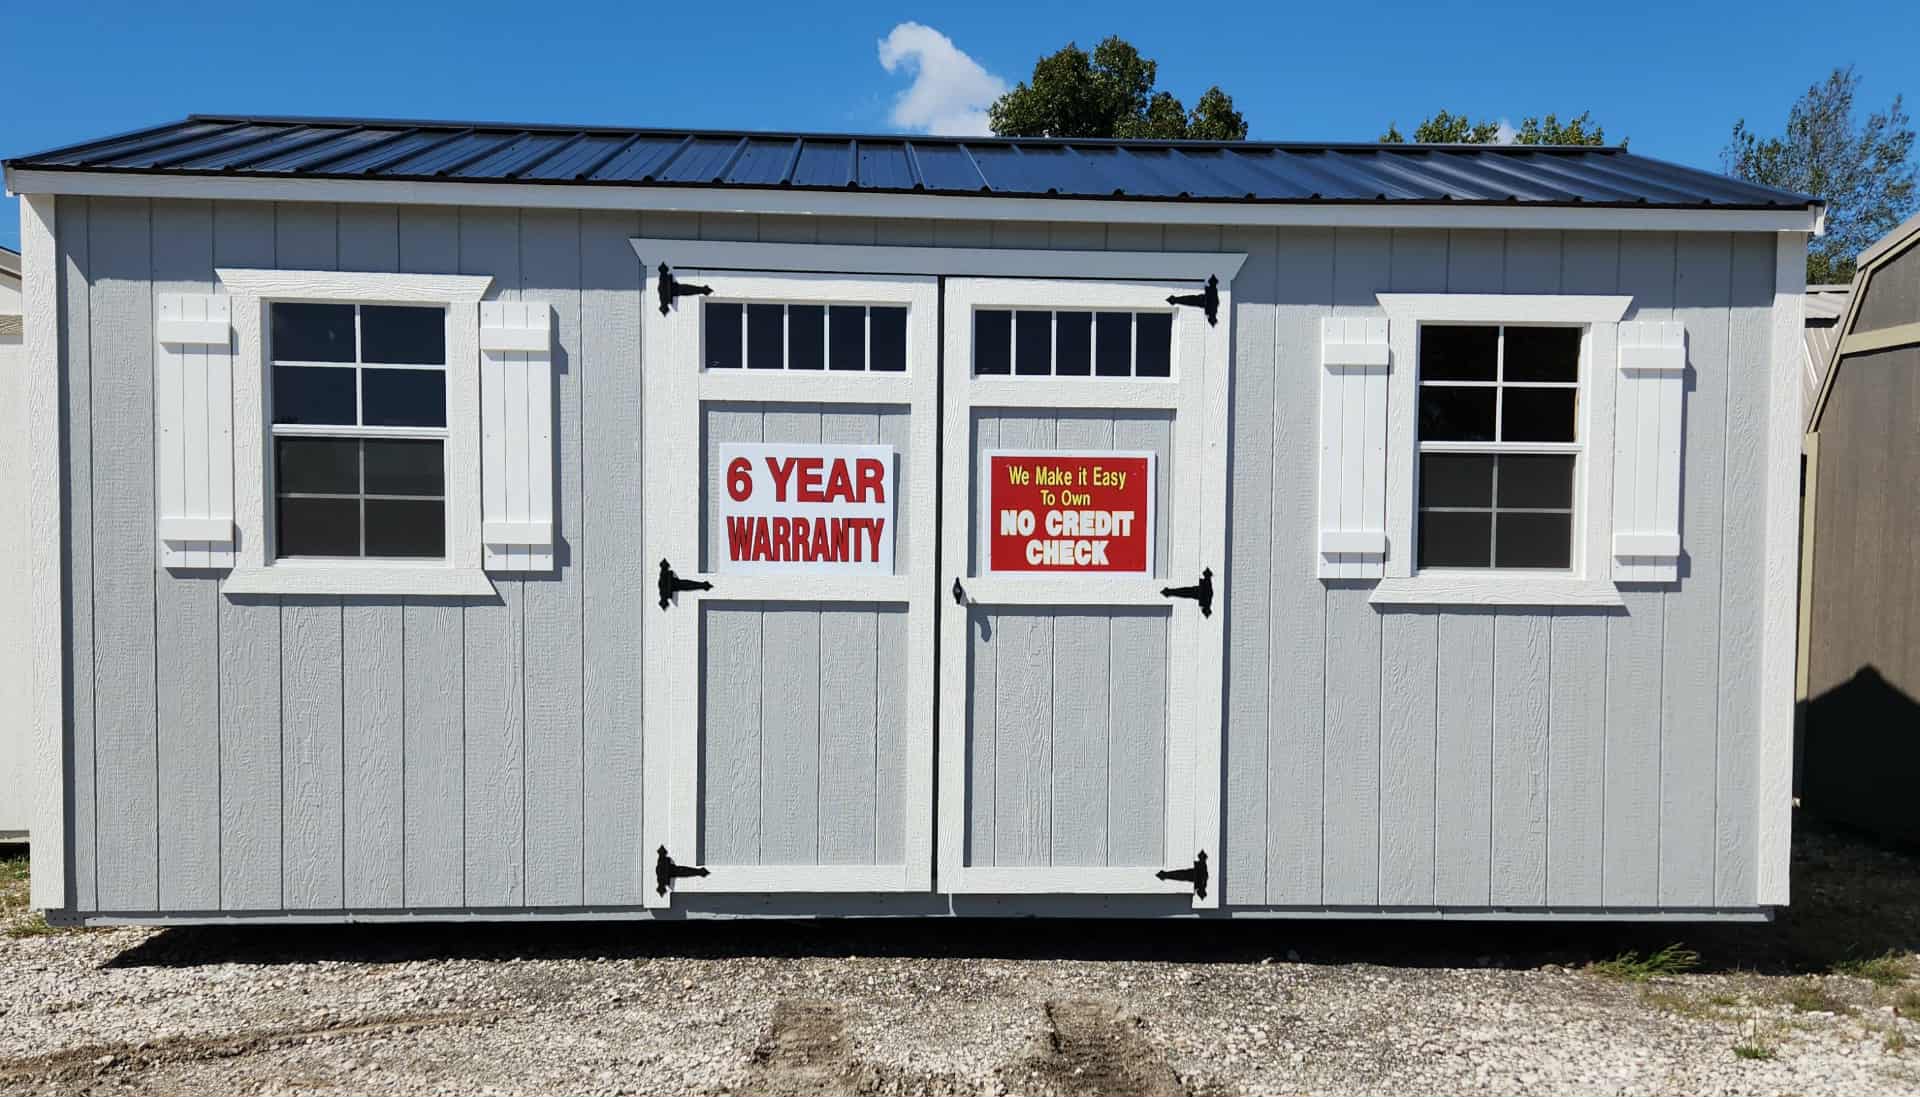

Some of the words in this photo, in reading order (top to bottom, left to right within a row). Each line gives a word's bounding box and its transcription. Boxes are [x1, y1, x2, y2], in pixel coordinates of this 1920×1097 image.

[726, 456, 753, 502] 6
[765, 457, 886, 503] YEAR
[1008, 465, 1030, 486] We
[1035, 466, 1073, 486] Make
[1078, 466, 1088, 486] it
[1093, 467, 1127, 490] Easy
[1040, 489, 1056, 506] To
[1061, 489, 1091, 506] Own
[1000, 509, 1036, 536] NO
[1045, 510, 1135, 537] CREDIT
[726, 515, 886, 563] WARRANTY
[1025, 539, 1110, 566] CHECK
